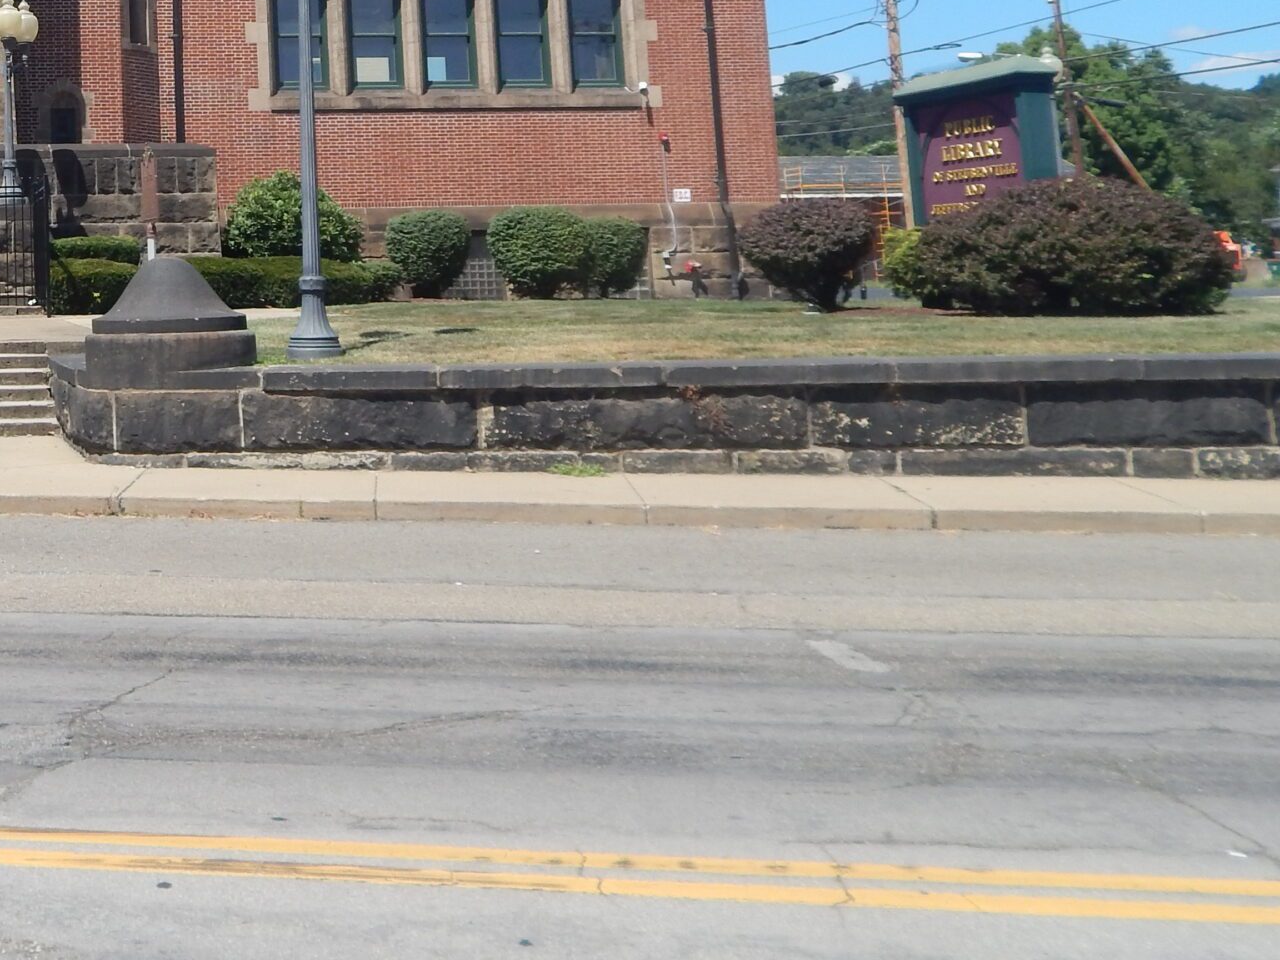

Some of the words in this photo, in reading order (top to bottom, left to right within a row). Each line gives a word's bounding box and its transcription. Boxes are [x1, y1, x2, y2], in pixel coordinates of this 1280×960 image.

[944, 116, 996, 137] PUBLIC
[941, 138, 1003, 162] LIBRARY
[964, 183, 987, 197] AND
